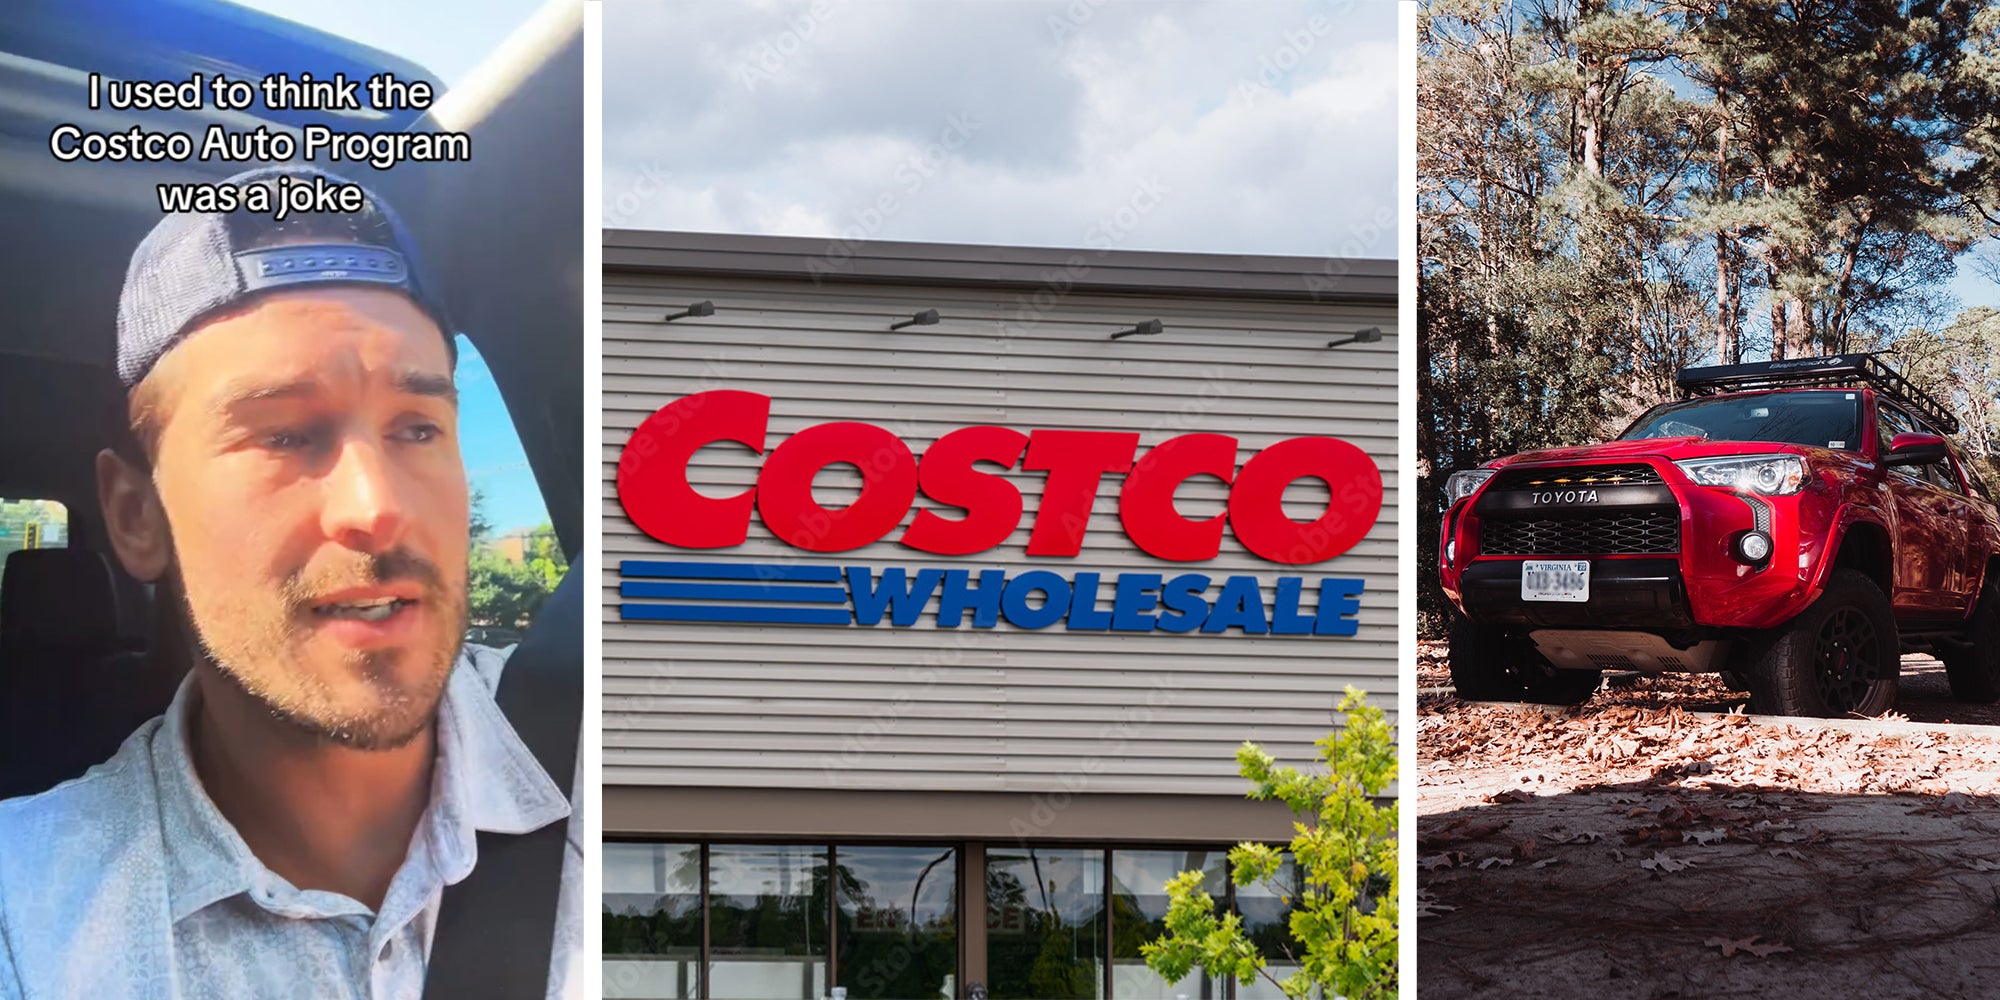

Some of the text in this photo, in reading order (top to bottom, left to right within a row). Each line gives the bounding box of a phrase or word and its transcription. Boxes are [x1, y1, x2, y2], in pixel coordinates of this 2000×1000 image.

[617, 389, 1383, 565] COSTCO
[1532, 490, 1598, 504] TOYOTA
[1540, 563, 1572, 571] VIRGINIA
[845, 566, 1365, 636] WHOLESALE
